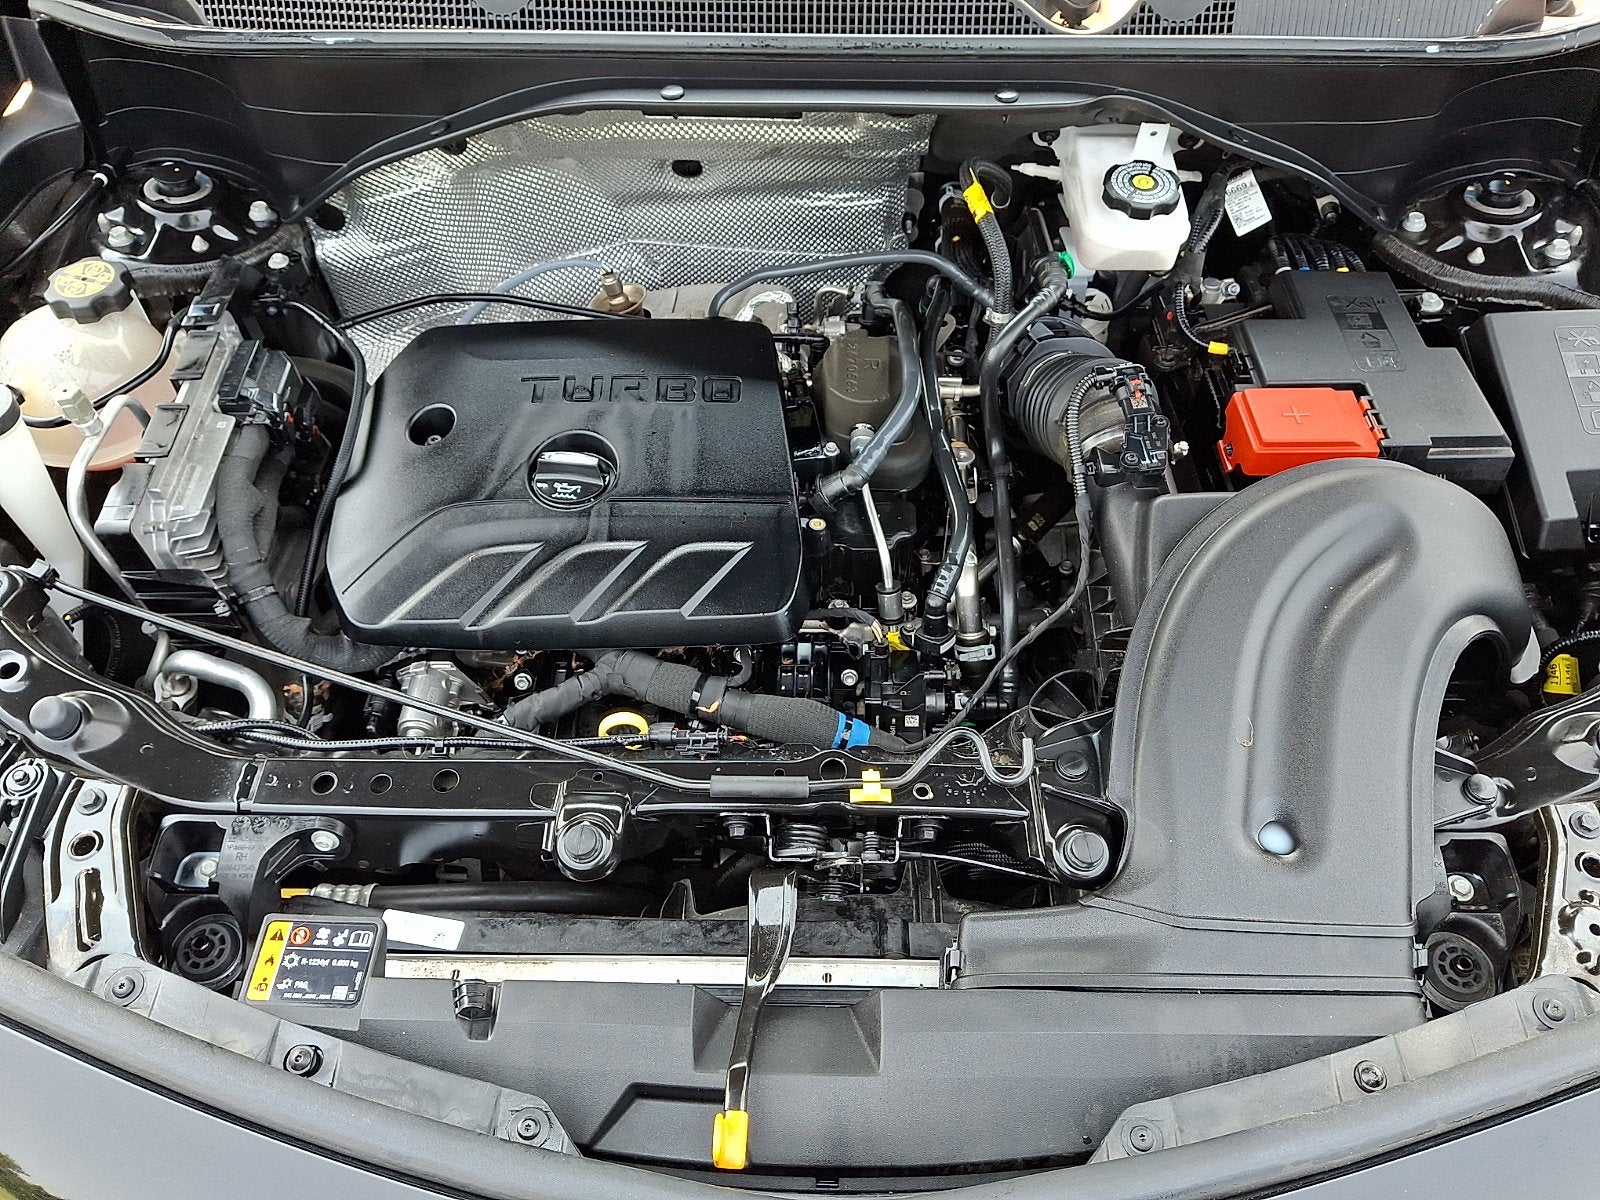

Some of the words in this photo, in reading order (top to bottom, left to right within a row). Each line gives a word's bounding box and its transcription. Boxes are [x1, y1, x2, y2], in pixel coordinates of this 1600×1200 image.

[863, 358, 881, 371] R
[521, 374, 743, 404] TURBO
[1550, 663, 1559, 686] 1146
[235, 851, 248, 861] RH
